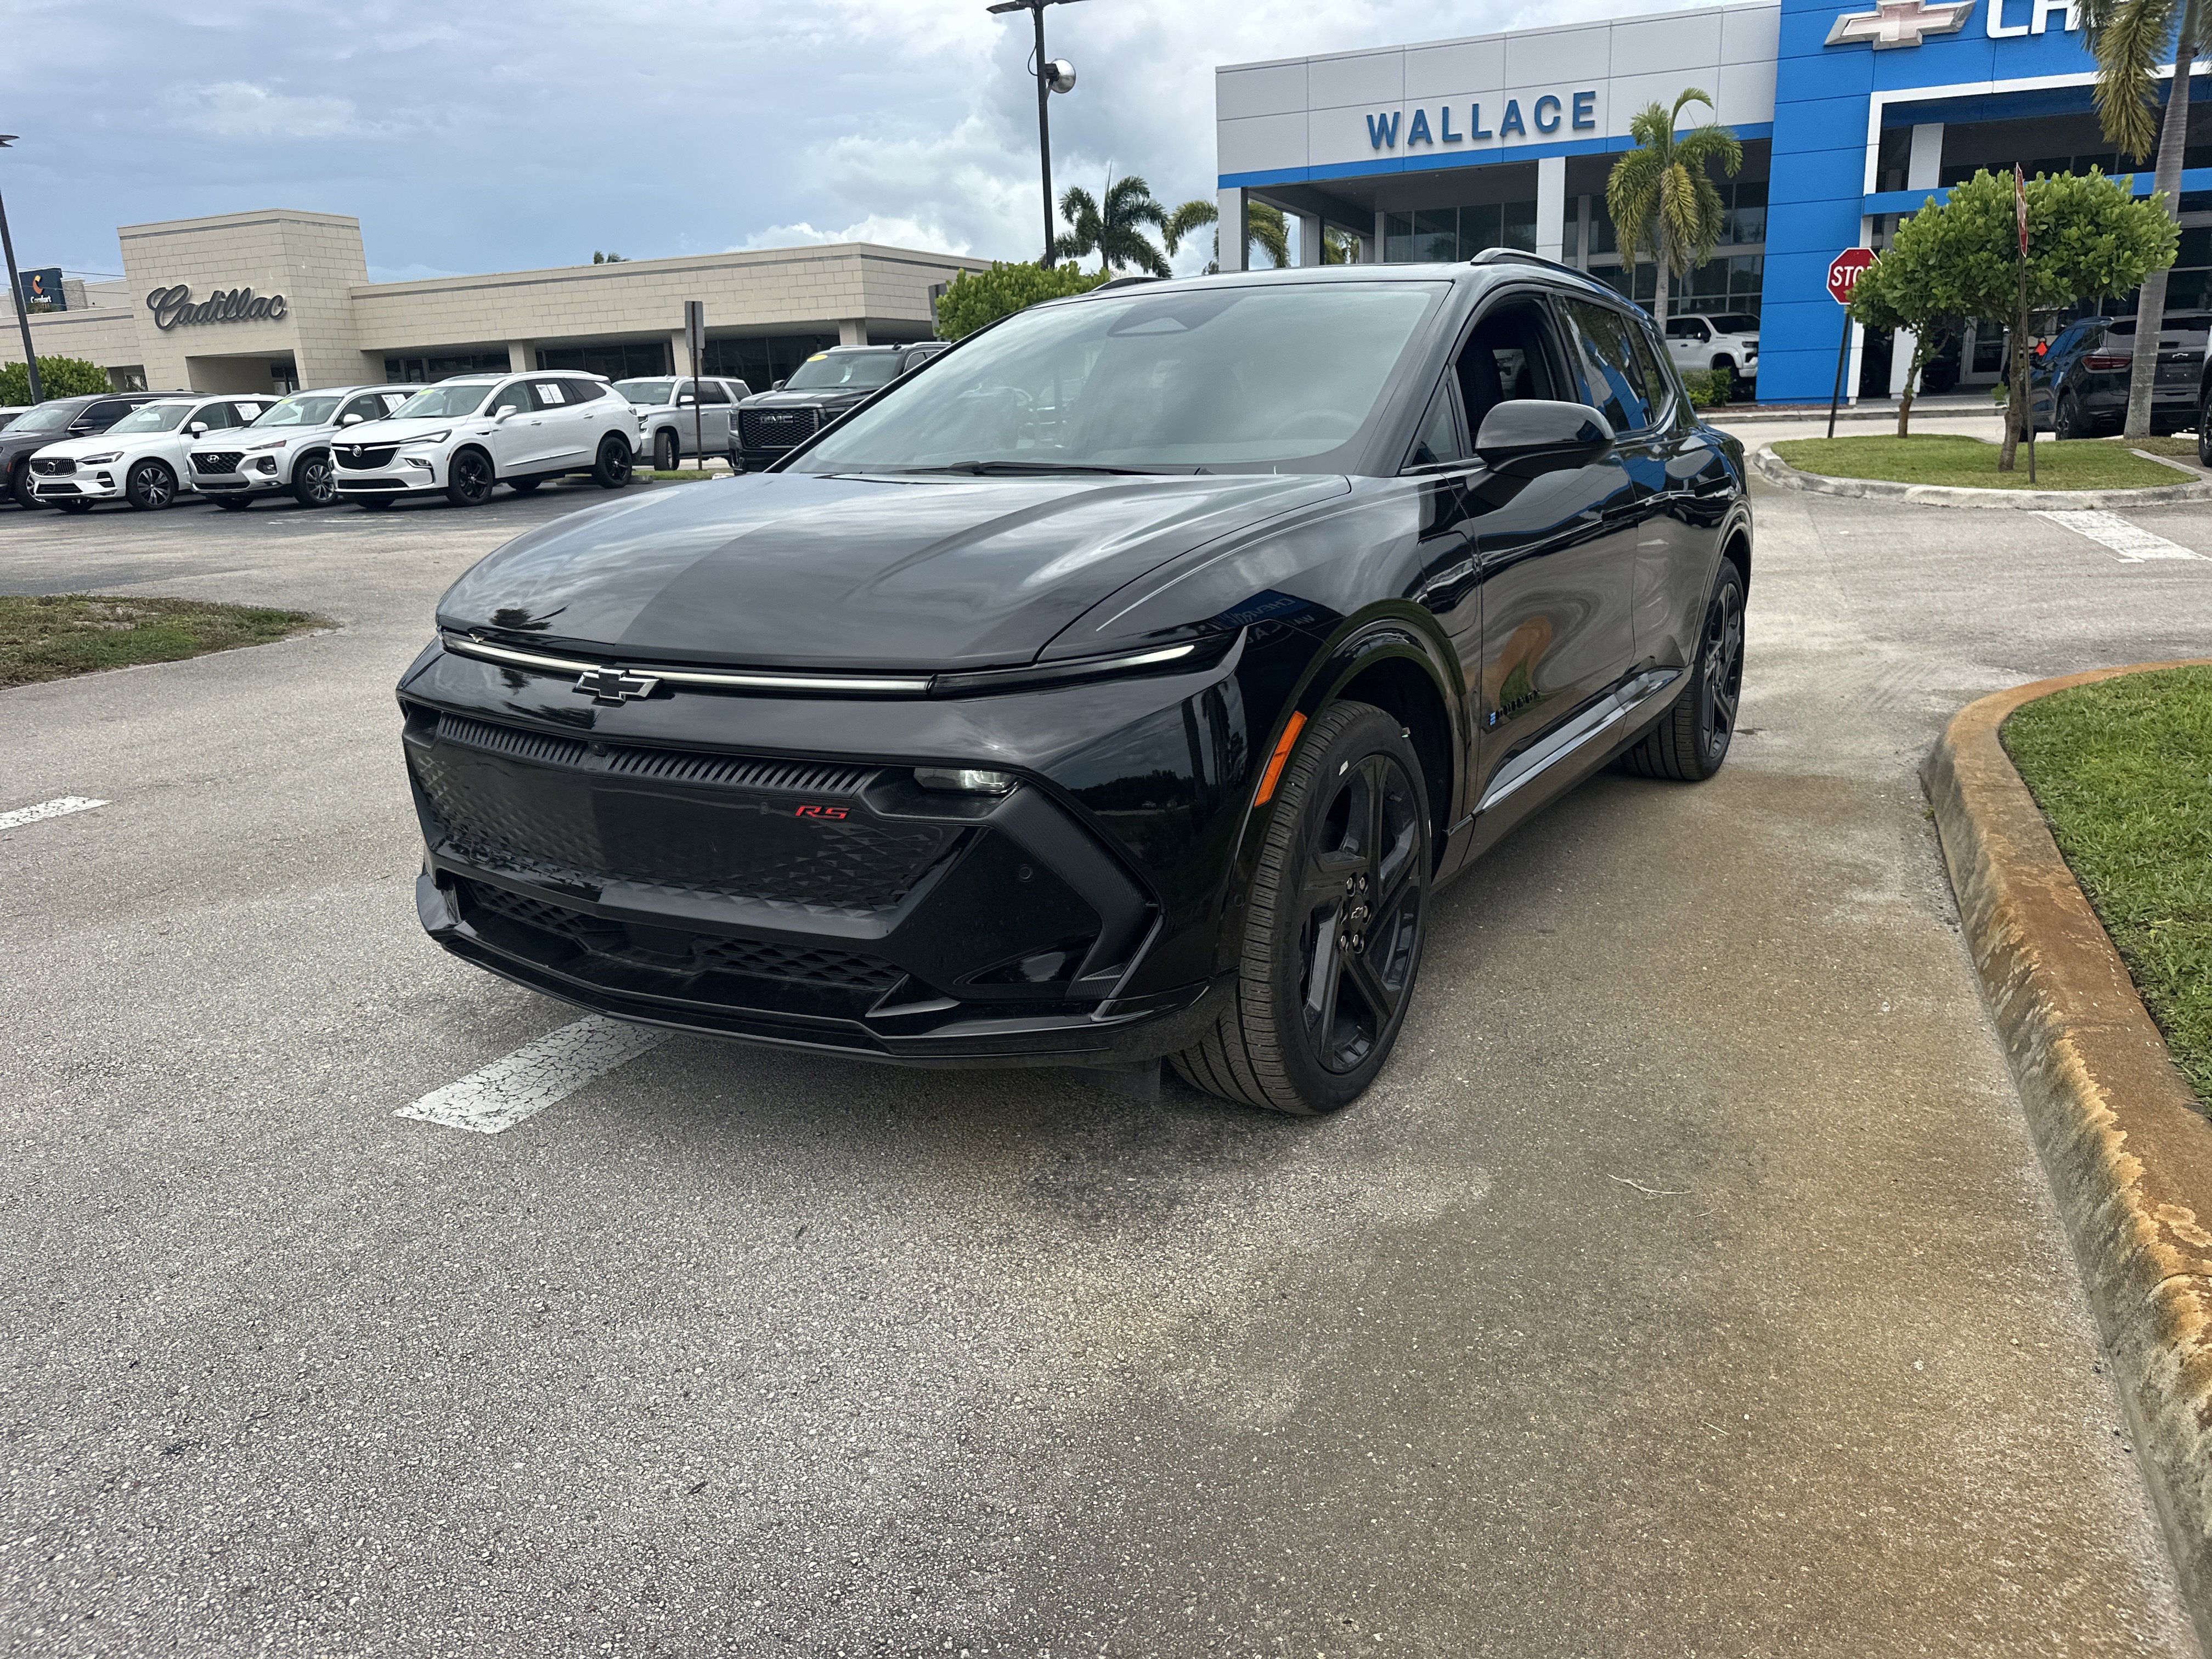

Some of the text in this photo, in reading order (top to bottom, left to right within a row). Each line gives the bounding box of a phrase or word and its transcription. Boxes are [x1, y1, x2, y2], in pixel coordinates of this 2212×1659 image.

[1366, 91, 1596, 149] WALLACE
[1831, 266, 1872, 286] STO
[146, 284, 287, 330] Cadillac
[760, 415, 793, 424] GMC
[794, 805, 851, 819] RS
